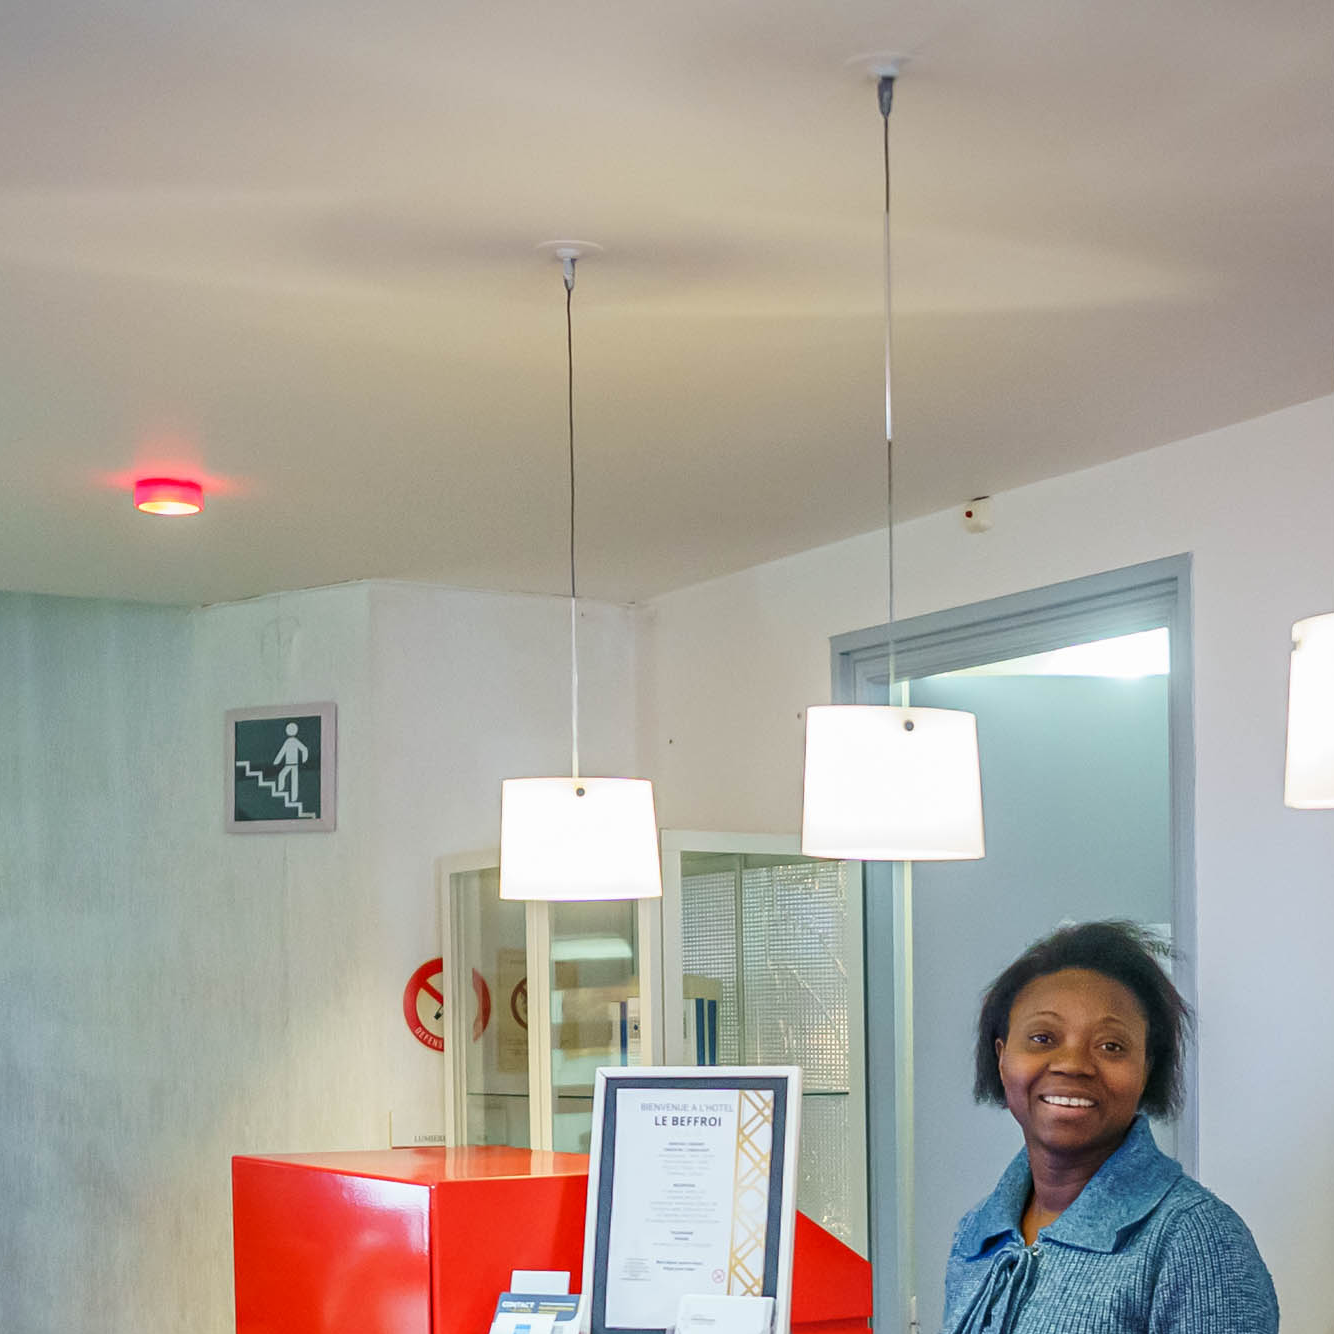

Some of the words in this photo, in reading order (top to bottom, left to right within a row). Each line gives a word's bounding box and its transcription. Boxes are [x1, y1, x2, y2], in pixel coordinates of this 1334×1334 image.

[414, 1026, 444, 1049] DEFENS
[640, 1103, 689, 1112] BIENVENUE
[654, 1116, 668, 1126] LE
[671, 1116, 722, 1127] BEFFROI
[414, 1135, 446, 1143] LUMIER
